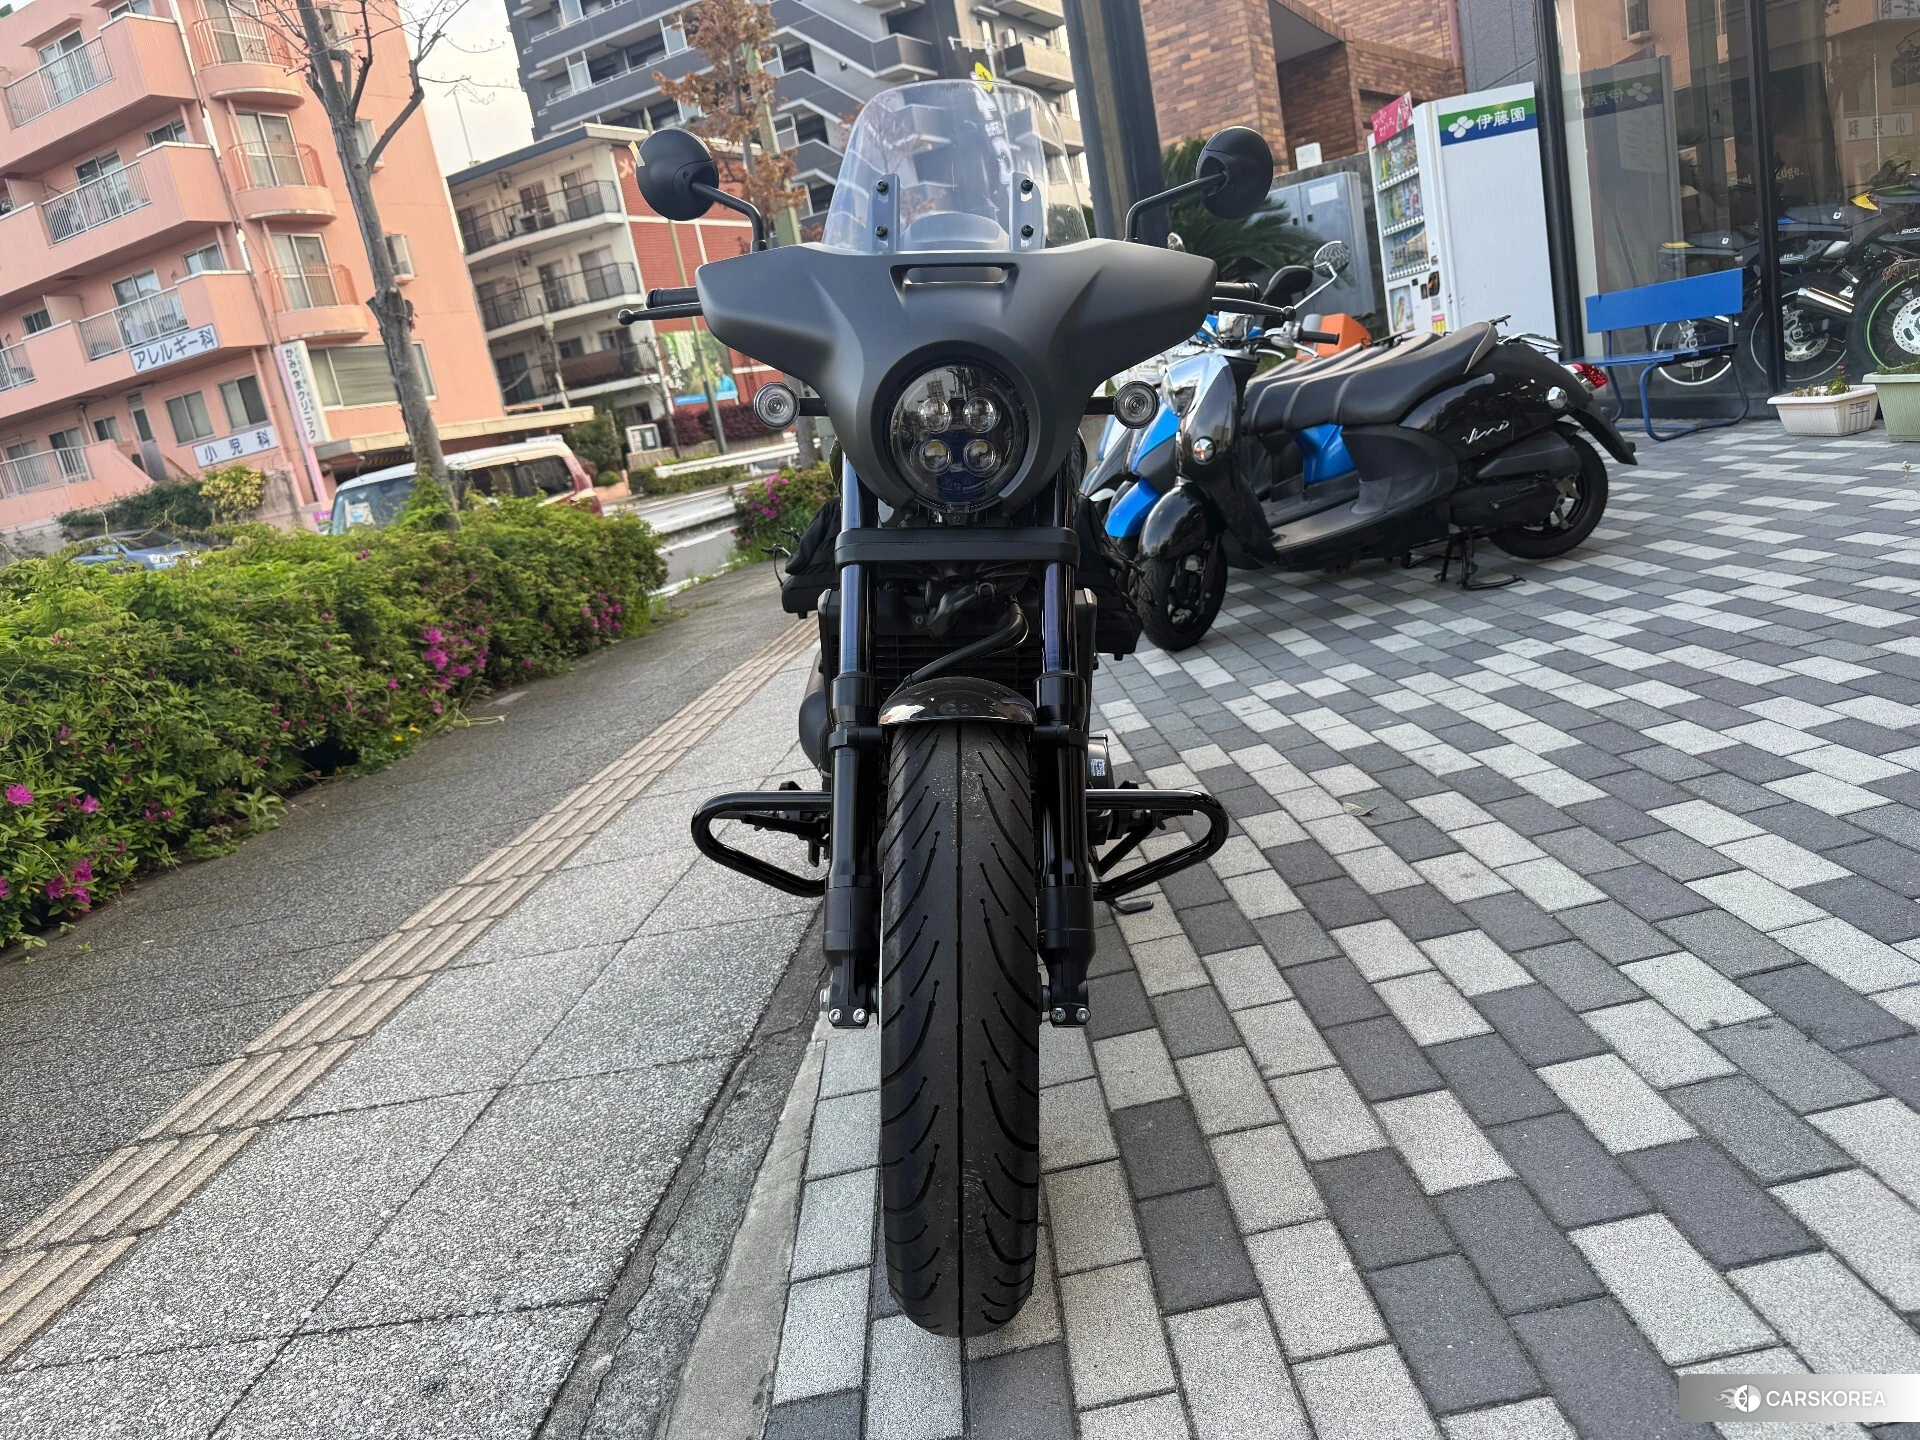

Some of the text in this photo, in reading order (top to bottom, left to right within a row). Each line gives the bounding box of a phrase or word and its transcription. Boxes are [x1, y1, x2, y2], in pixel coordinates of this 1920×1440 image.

[1476, 106, 1526, 130] 伊藤園
[133, 327, 217, 370] アレルギー科
[285, 348, 316, 440] かみやまクリニック
[204, 429, 271, 463] 小児科
